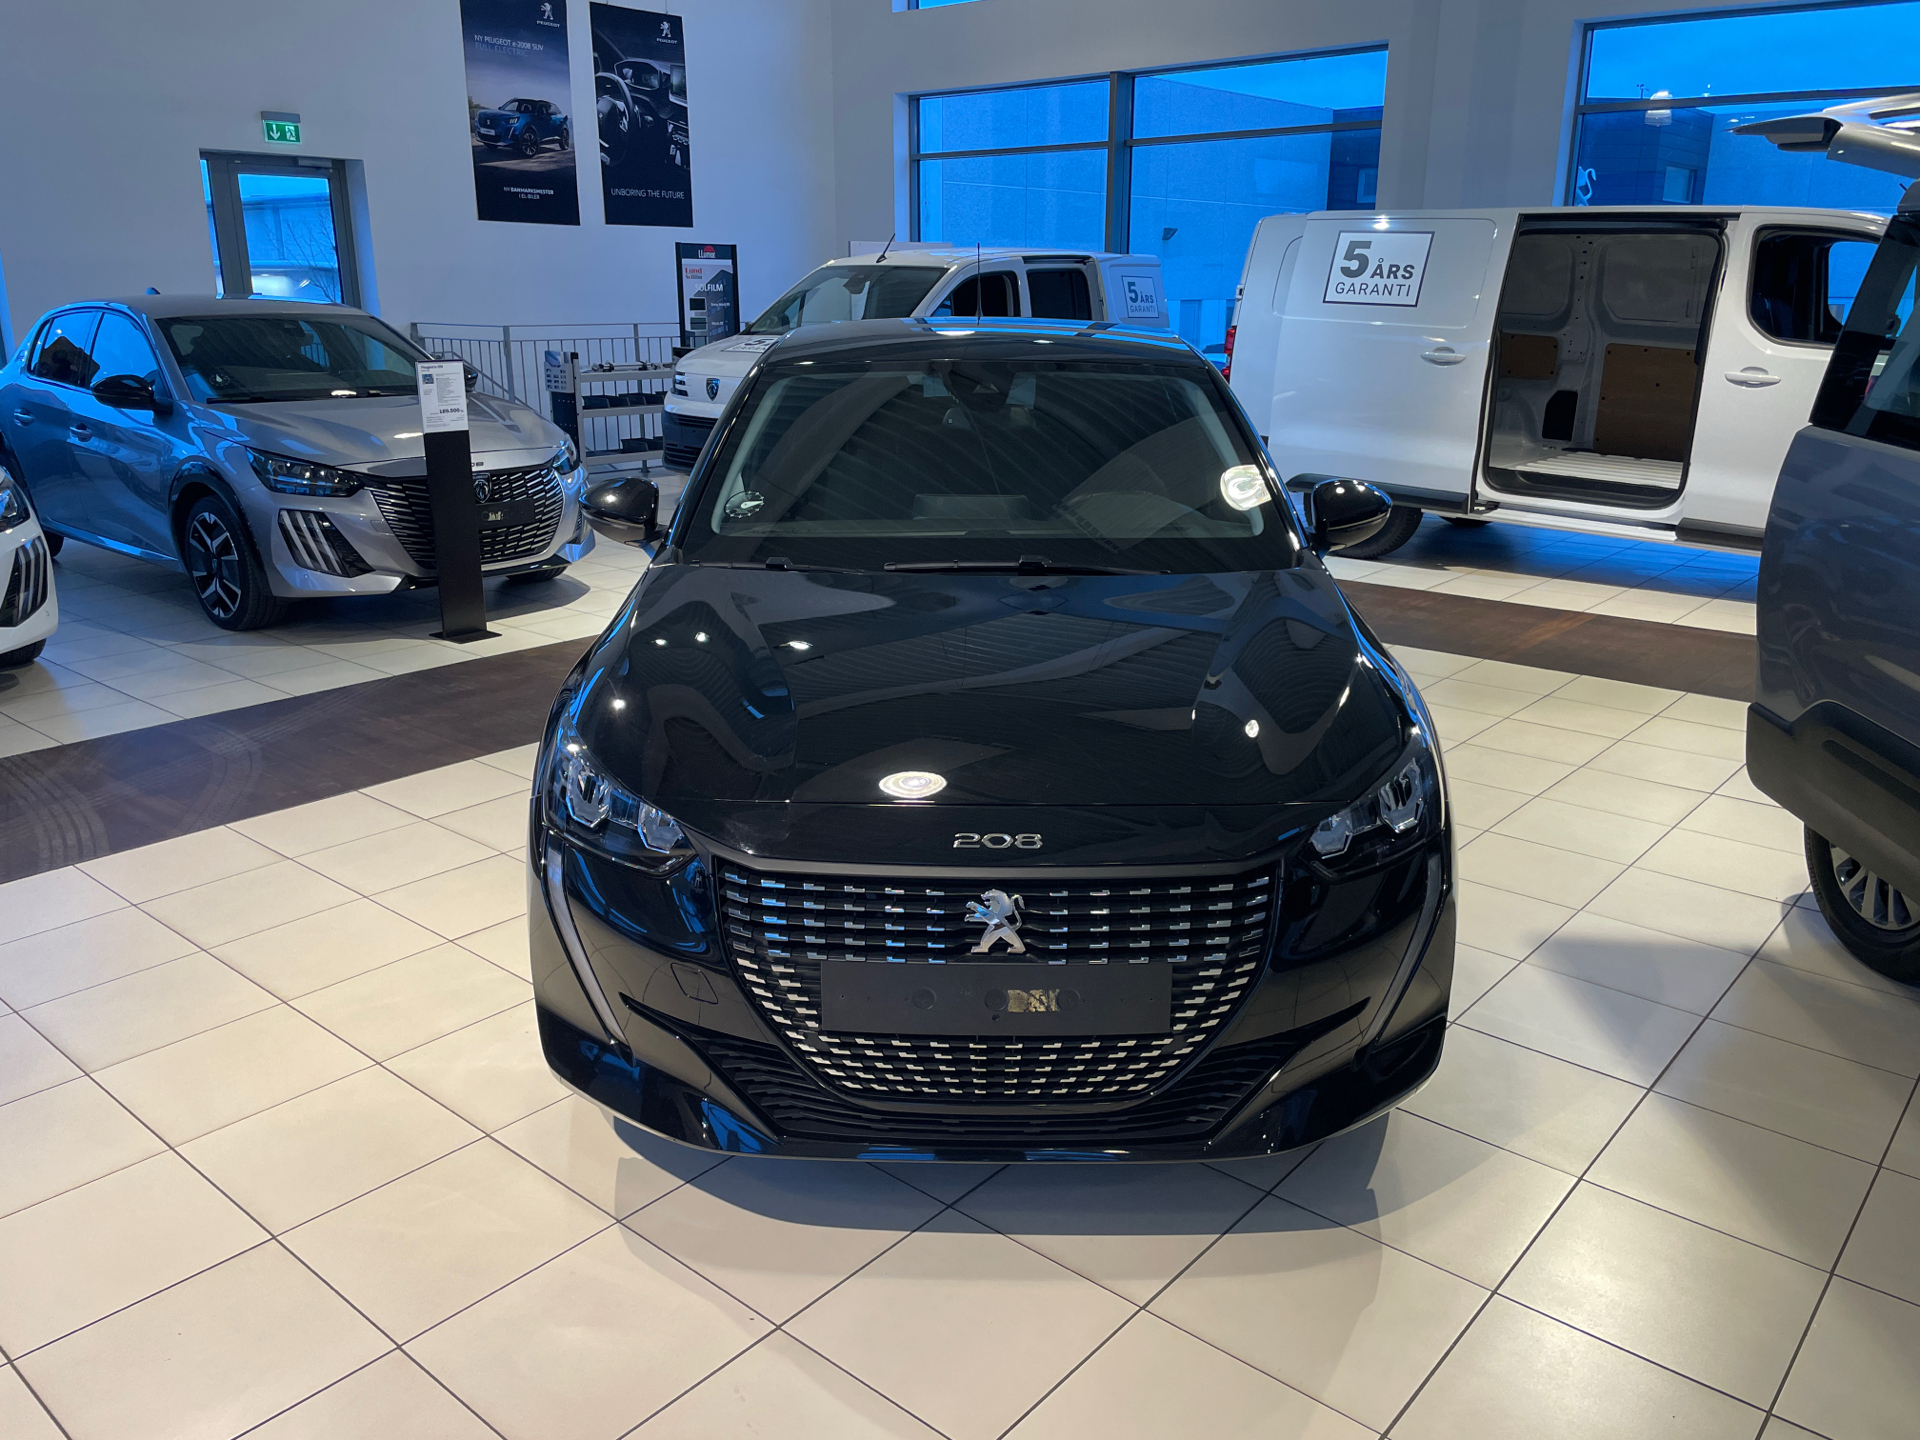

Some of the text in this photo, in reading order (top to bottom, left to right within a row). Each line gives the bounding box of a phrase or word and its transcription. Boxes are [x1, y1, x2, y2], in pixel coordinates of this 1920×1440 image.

[474, 34, 544, 51] NY PEUGEOT e-2008 SUV
[610, 188, 685, 200] UNBORING THE FUTURE
[1340, 240, 1415, 280] 5 ÅRS
[694, 283, 724, 292] SOLFILM
[1127, 281, 1154, 304] 5 ÅRS
[1334, 281, 1412, 297] GARANTI
[1129, 305, 1156, 313] GARANTI
[952, 832, 1044, 850] 208
